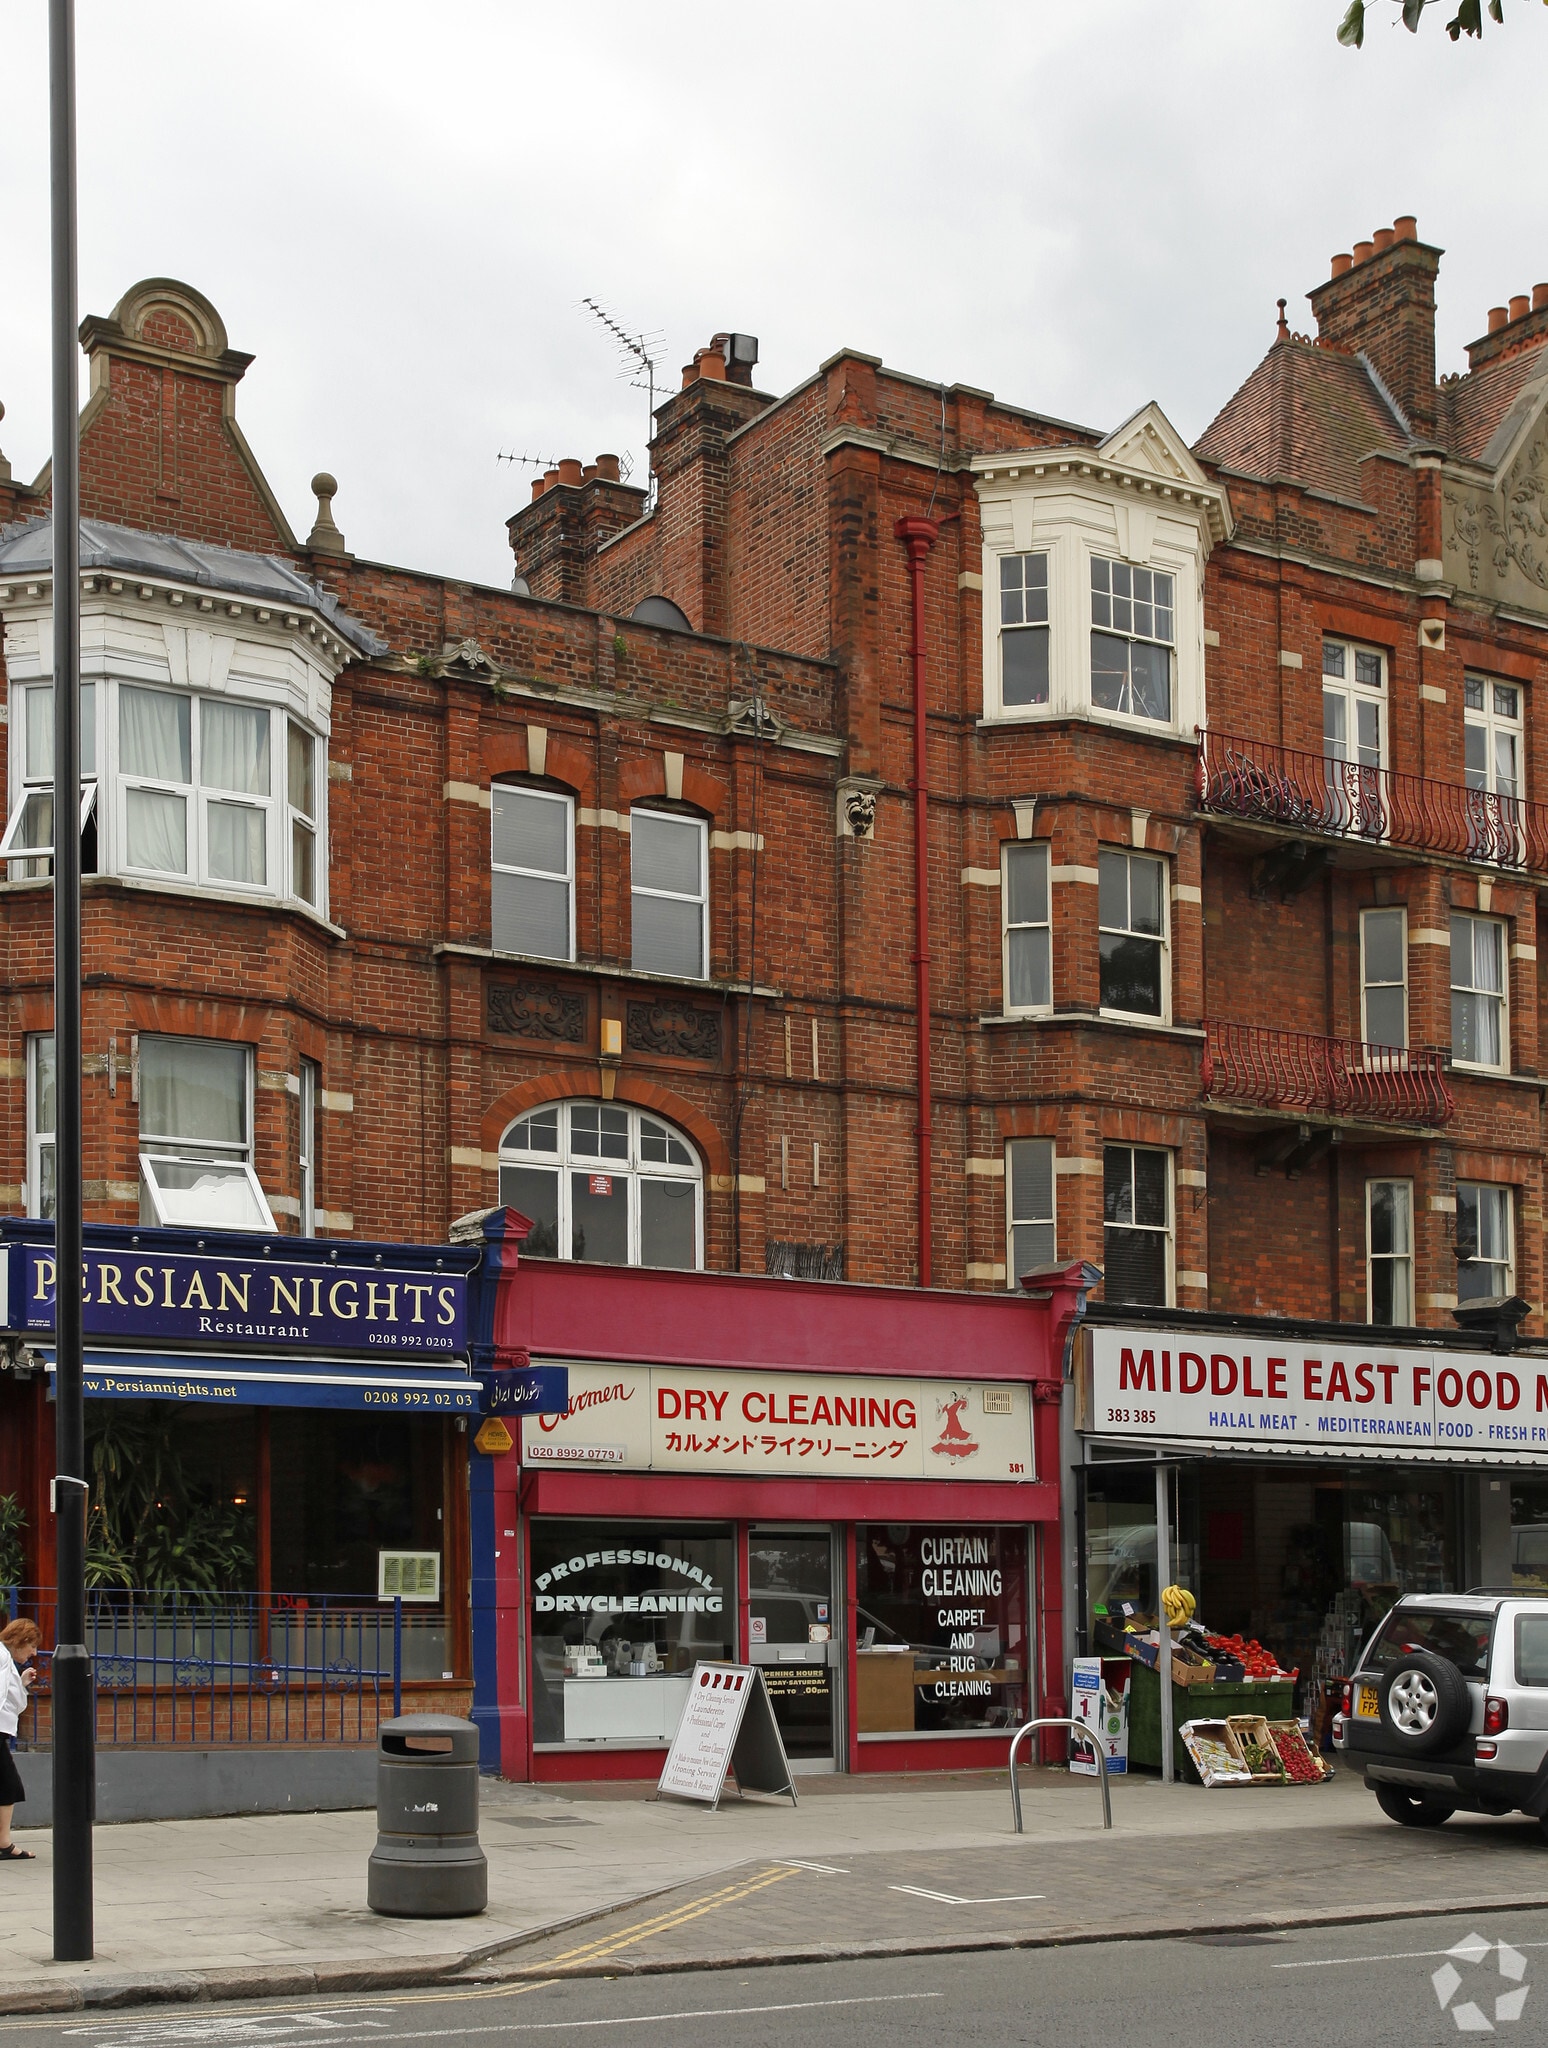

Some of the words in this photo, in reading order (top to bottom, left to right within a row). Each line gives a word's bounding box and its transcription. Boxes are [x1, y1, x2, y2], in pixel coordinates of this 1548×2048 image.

[269, 1275, 456, 1325] NIGHTS
[199, 1316, 309, 1338] Restaurant
[369, 1333, 397, 1345] 0208
[401, 1335, 422, 1346] 992
[426, 1336, 453, 1348] 0203
[82, 1378, 237, 1397] w.Persiannights.net
[1119, 1347, 1288, 1399] MIDDLE
[1303, 1359, 1399, 1405] EAST
[1412, 1366, 1521, 1411] FOOD
[363, 1391, 398, 1404] 0208
[403, 1392, 430, 1405] 992
[434, 1393, 451, 1405] 02
[456, 1394, 473, 1406] 03
[657, 1387, 730, 1422] DRY
[741, 1391, 917, 1430] CLEANING
[1107, 1407, 1130, 1423] 383
[1133, 1408, 1156, 1424] 385
[1209, 1411, 1255, 1429] HALAL
[1259, 1413, 1298, 1431] MEAT
[1318, 1416, 1432, 1437] MEDITERRANEAN
[1438, 1421, 1474, 1438] FOOD
[1489, 1424, 1528, 1440] FRESH
[1531, 1426, 1548, 1442] FR
[533, 1447, 553, 1457] 020
[557, 1447, 585, 1458] 8992
[588, 1449, 615, 1459] 0779
[665, 1431, 909, 1459] カルメンドライクリーニング
[1009, 1463, 1024, 1473] 381
[921, 1537, 989, 1566] CURTAIN
[534, 1549, 714, 1592] PROFESSIONAL
[922, 1568, 1002, 1597] CLEANING
[535, 1595, 723, 1613] DRYCLEANING
[937, 1609, 986, 1627] CARPET
[950, 1632, 975, 1650] AND
[796, 1669, 824, 1677] HOURS
[950, 1656, 976, 1674] RUG
[935, 1679, 992, 1698] CLEANING
